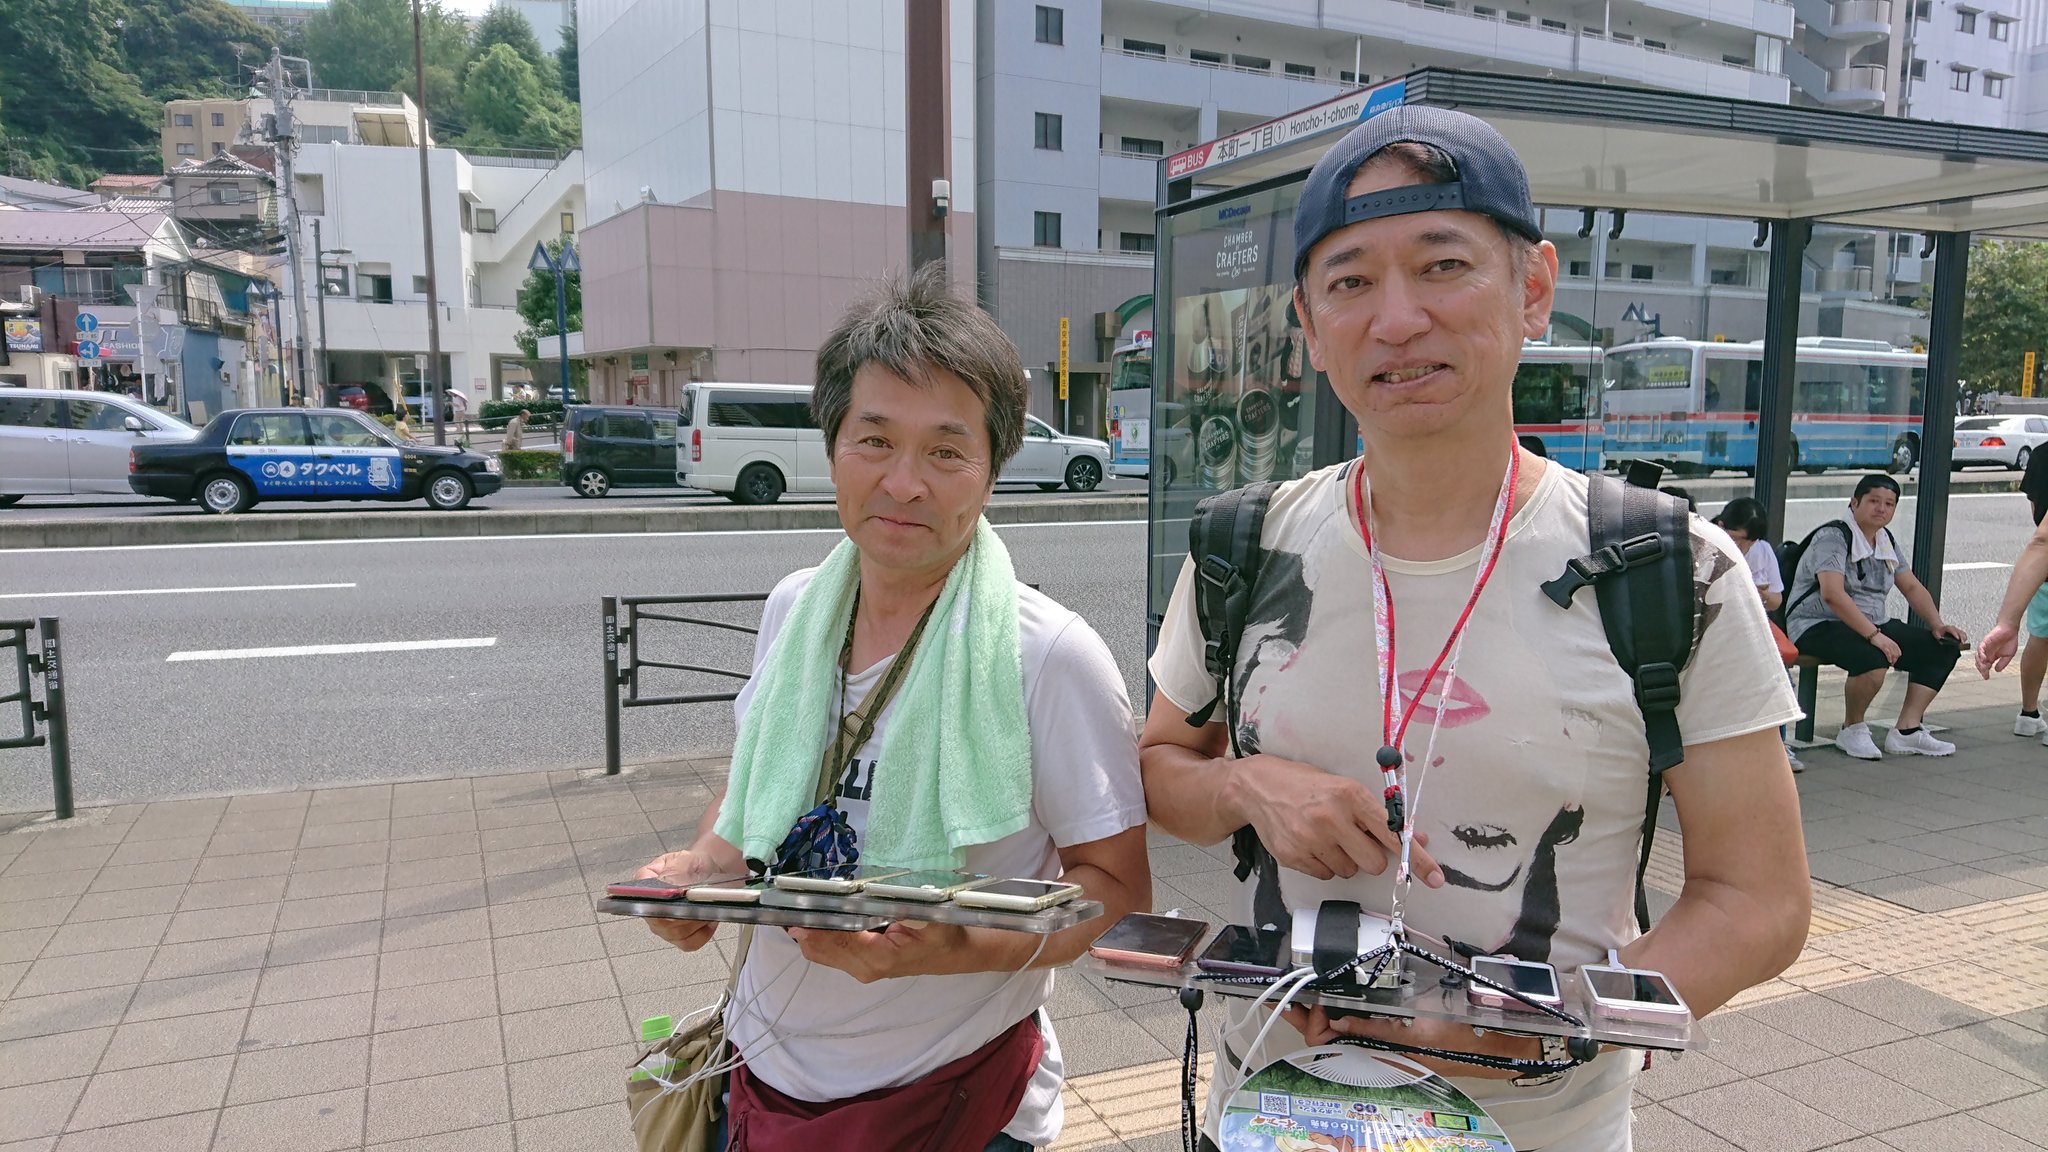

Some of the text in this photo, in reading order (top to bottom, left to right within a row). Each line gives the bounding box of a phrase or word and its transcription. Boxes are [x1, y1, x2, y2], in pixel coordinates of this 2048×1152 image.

[1290, 101, 1359, 137] Honcho-1-chome
[1217, 121, 1286, 162] 本町一丁目①
[1187, 151, 1204, 167] BUS
[1223, 230, 1253, 248] CHAMBER
[1216, 244, 1258, 269] CRAFTERS
[103, 342, 141, 350] FASHIO
[300, 462, 361, 476] タクベル
[605, 615, 616, 661] 国土交通省
[1360, 943, 1392, 962] CROSS
[1399, 942, 1417, 952] LIN
[1327, 964, 1351, 980] LINE
[1374, 951, 1391, 977] STEP
[1429, 953, 1473, 975] ACROSS
